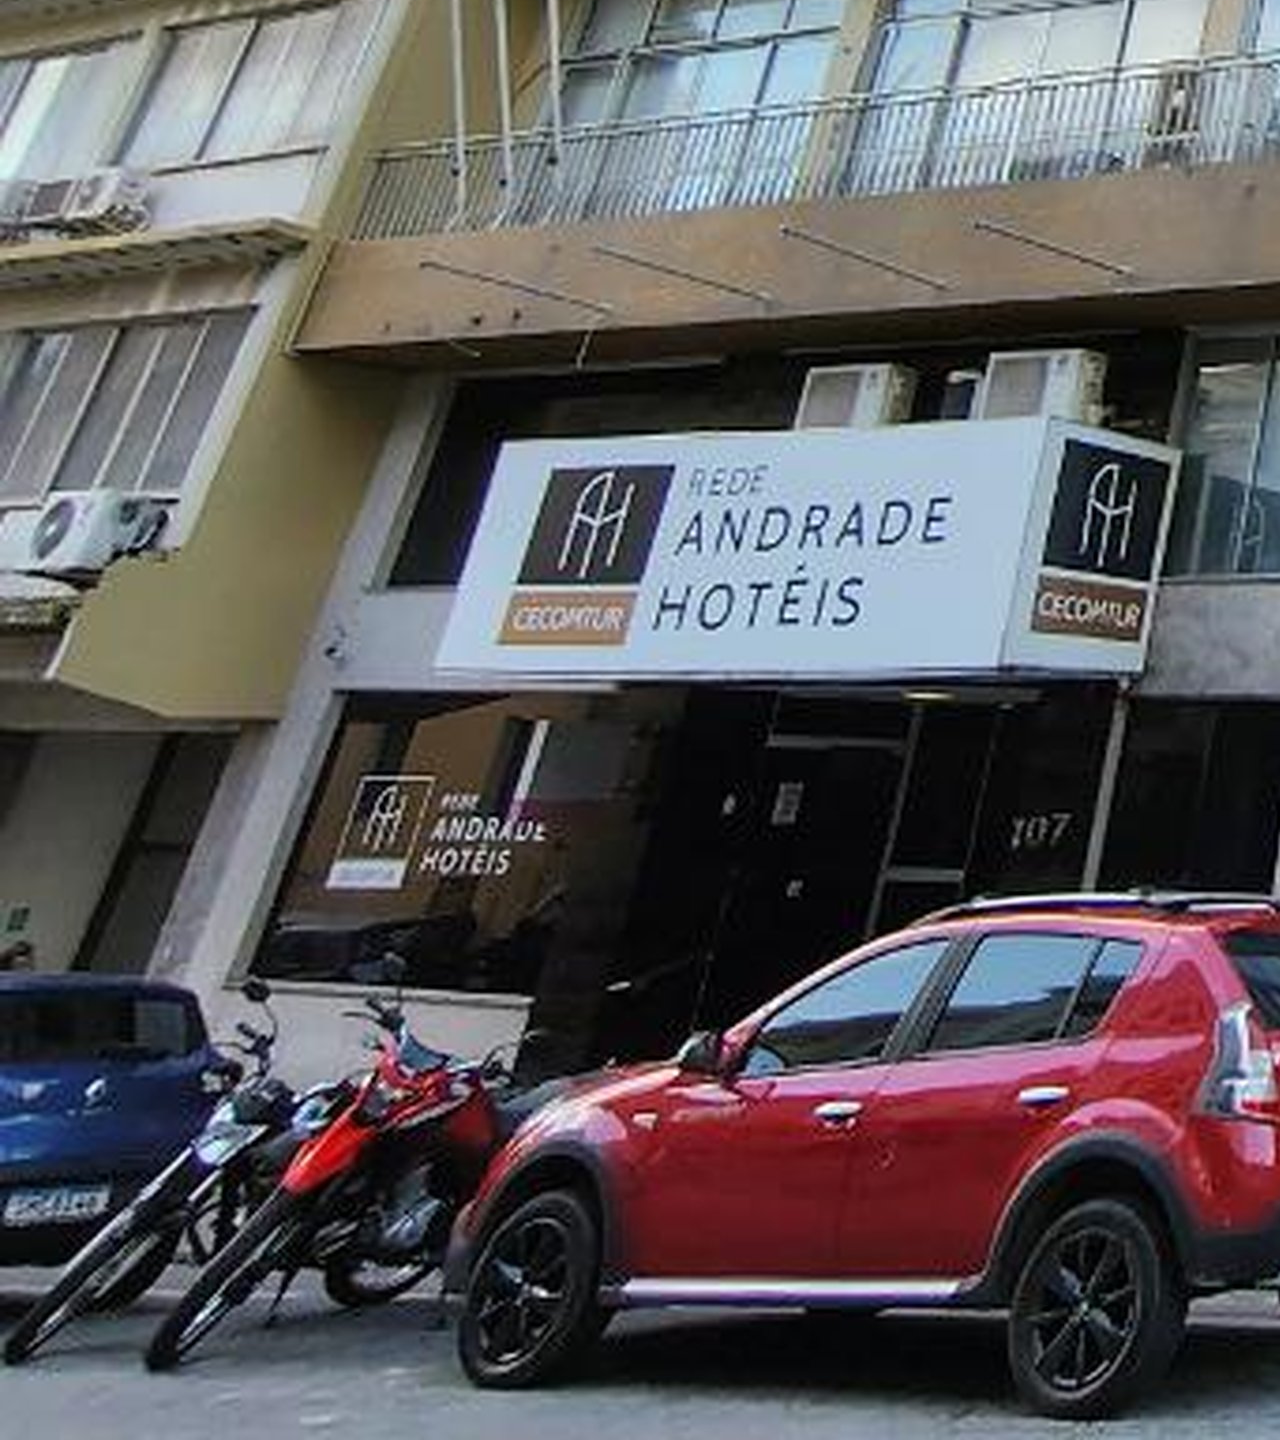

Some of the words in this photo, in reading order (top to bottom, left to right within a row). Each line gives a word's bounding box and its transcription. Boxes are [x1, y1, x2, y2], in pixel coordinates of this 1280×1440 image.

[689, 465, 769, 496] REDE
[674, 497, 953, 557] ANDRADE
[652, 564, 865, 632] HOTÉIS
[1038, 592, 1141, 628] CECOMTUR
[512, 604, 627, 633] CECOMTUR
[430, 817, 546, 842] ANDRADE
[1011, 812, 1073, 848] 107
[419, 842, 512, 876] HOTÉIS
